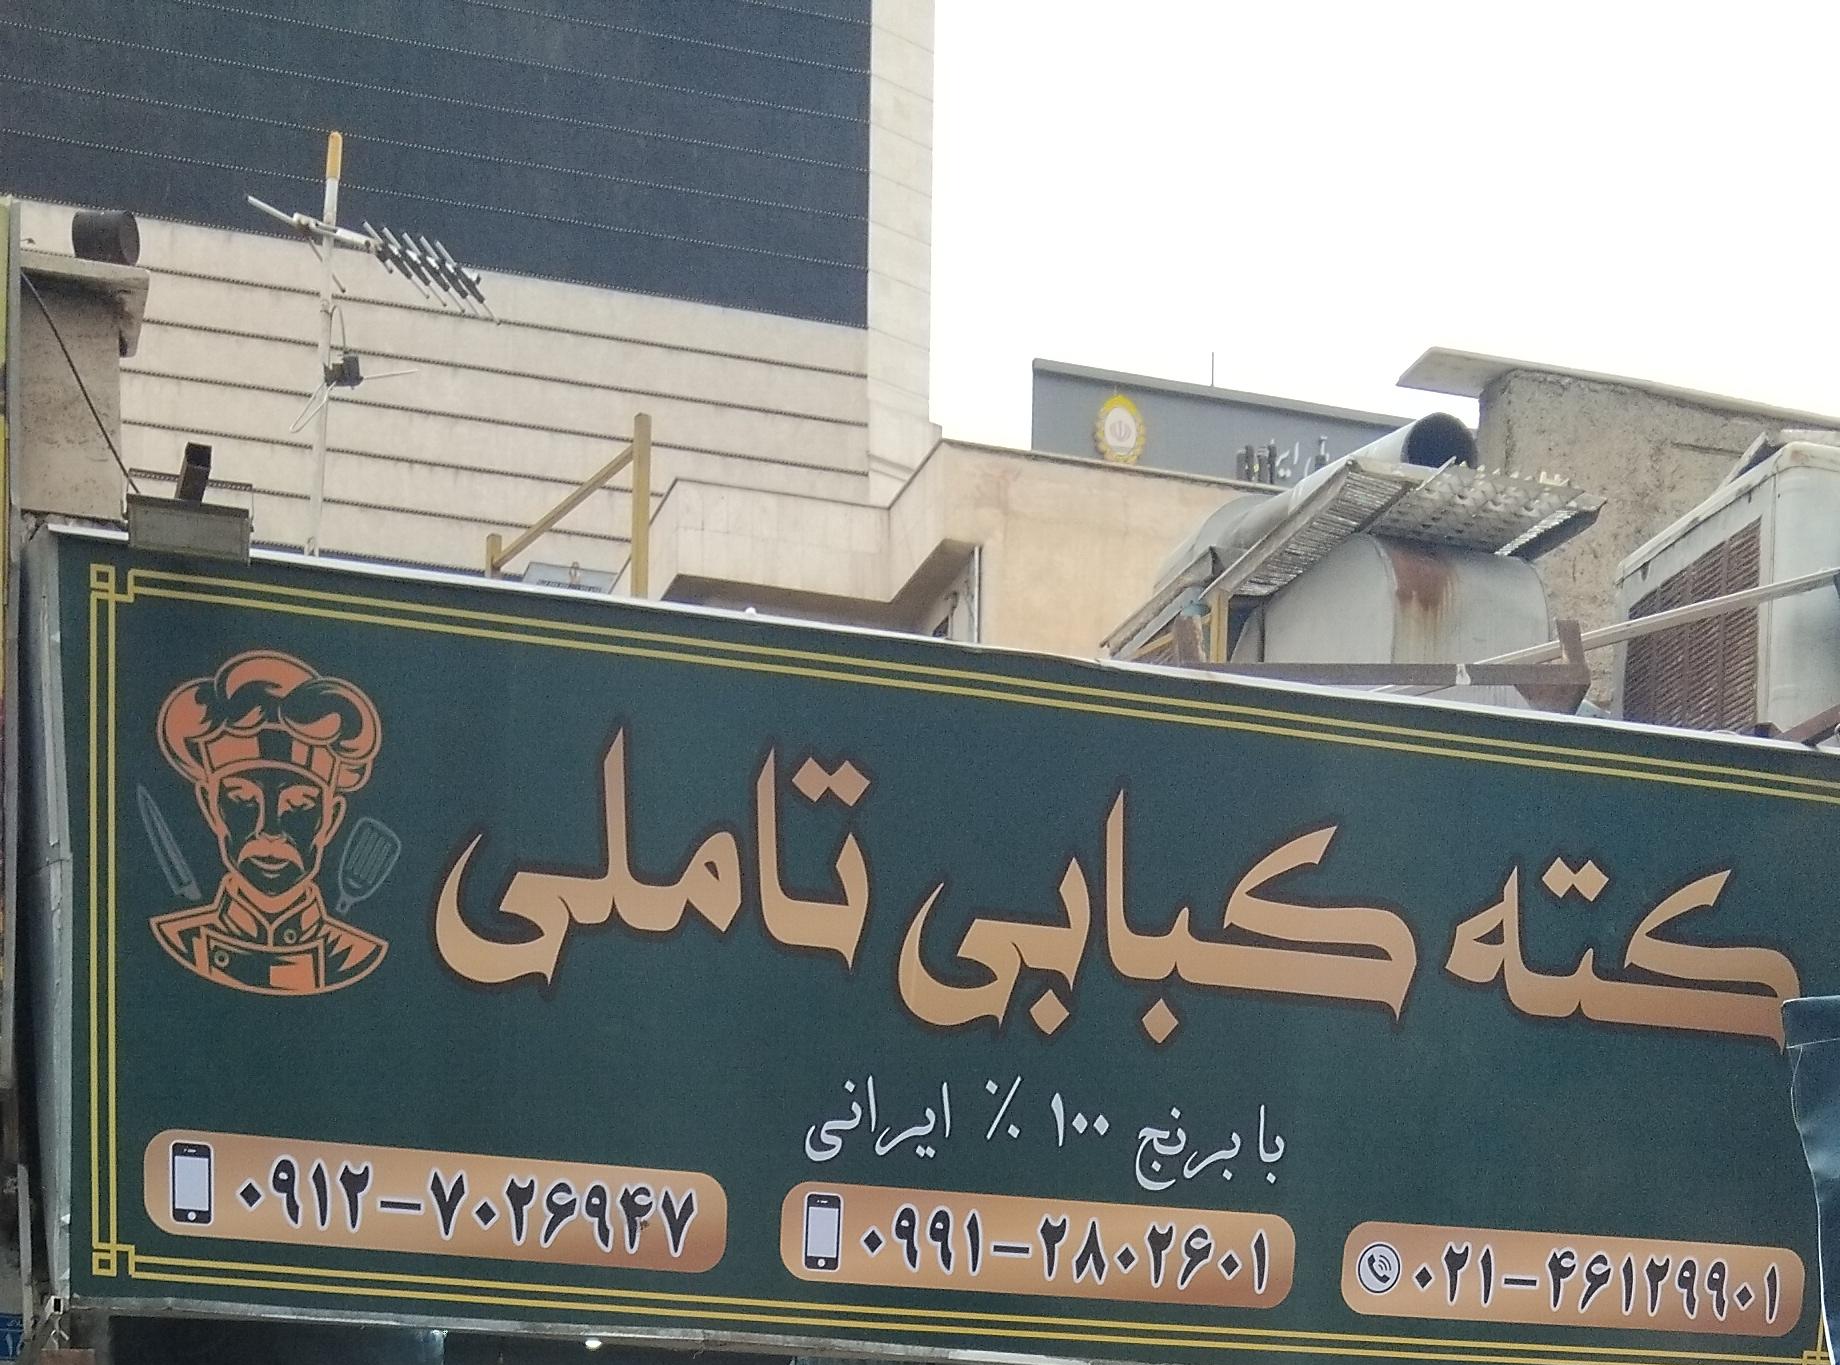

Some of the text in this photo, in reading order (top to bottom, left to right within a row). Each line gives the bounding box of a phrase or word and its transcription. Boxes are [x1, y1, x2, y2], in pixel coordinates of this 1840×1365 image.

[436, 726, 1801, 1053] کته کبابی تاملی
[804, 1075, 951, 1161] ایرانی
[1051, 1092, 1110, 1147] ۱۰۰
[1135, 1107, 1242, 1190] برنج
[1257, 1105, 1287, 1184] با
[236, 1154, 698, 1257] ۰۹۱۲-۷۰۲۶۹۴۷
[860, 1203, 1271, 1295] ۰۹۹۱-۲۸۰۲۶۰۱
[1413, 1242, 1781, 1324] ۰۲۱-۴۶۱۲۹۹۰۱
